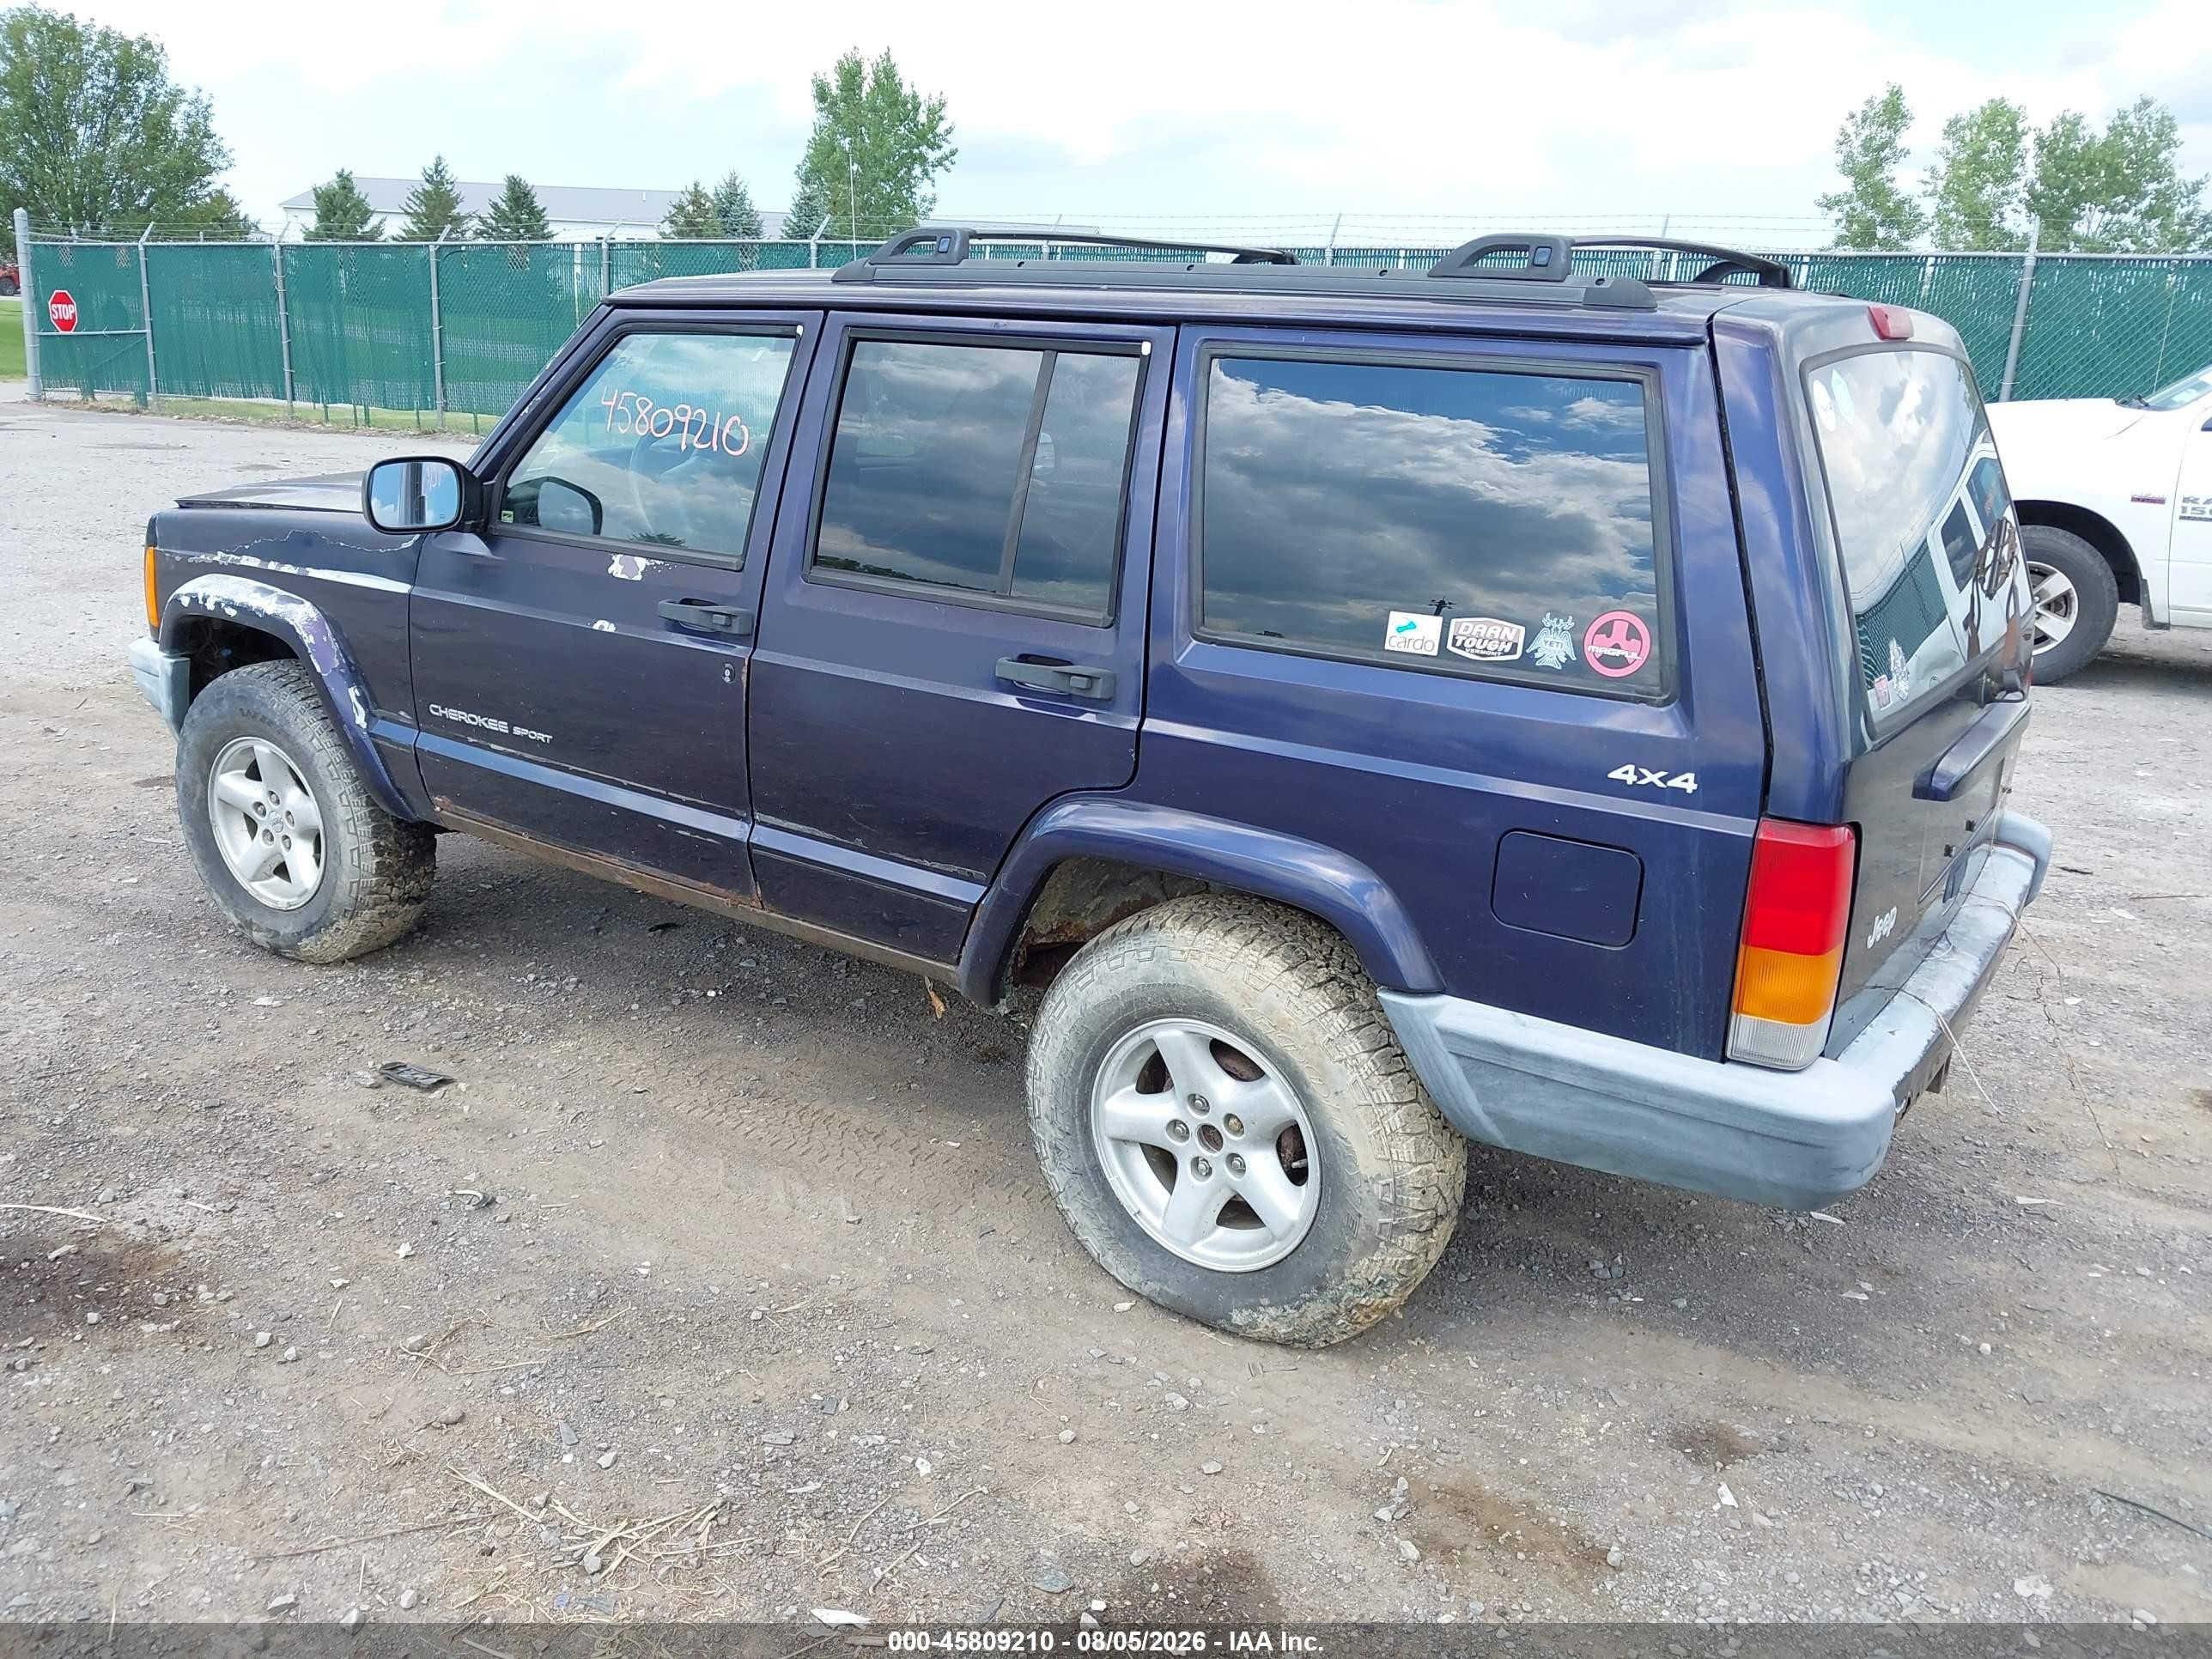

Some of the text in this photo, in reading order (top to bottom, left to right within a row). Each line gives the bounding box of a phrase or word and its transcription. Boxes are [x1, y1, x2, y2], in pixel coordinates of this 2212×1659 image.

[52, 303, 76, 320] STOP
[601, 386, 750, 456] 45809210
[1389, 635, 1435, 653] cardo
[1455, 635, 1513, 653] TOUGH
[1465, 647, 1503, 657] VERMONT
[1543, 639, 1565, 650] YETI
[1588, 645, 1643, 660] MAGPUL
[429, 703, 553, 744] CHEROKEE SPORT
[1867, 905, 1897, 950] Jeep
